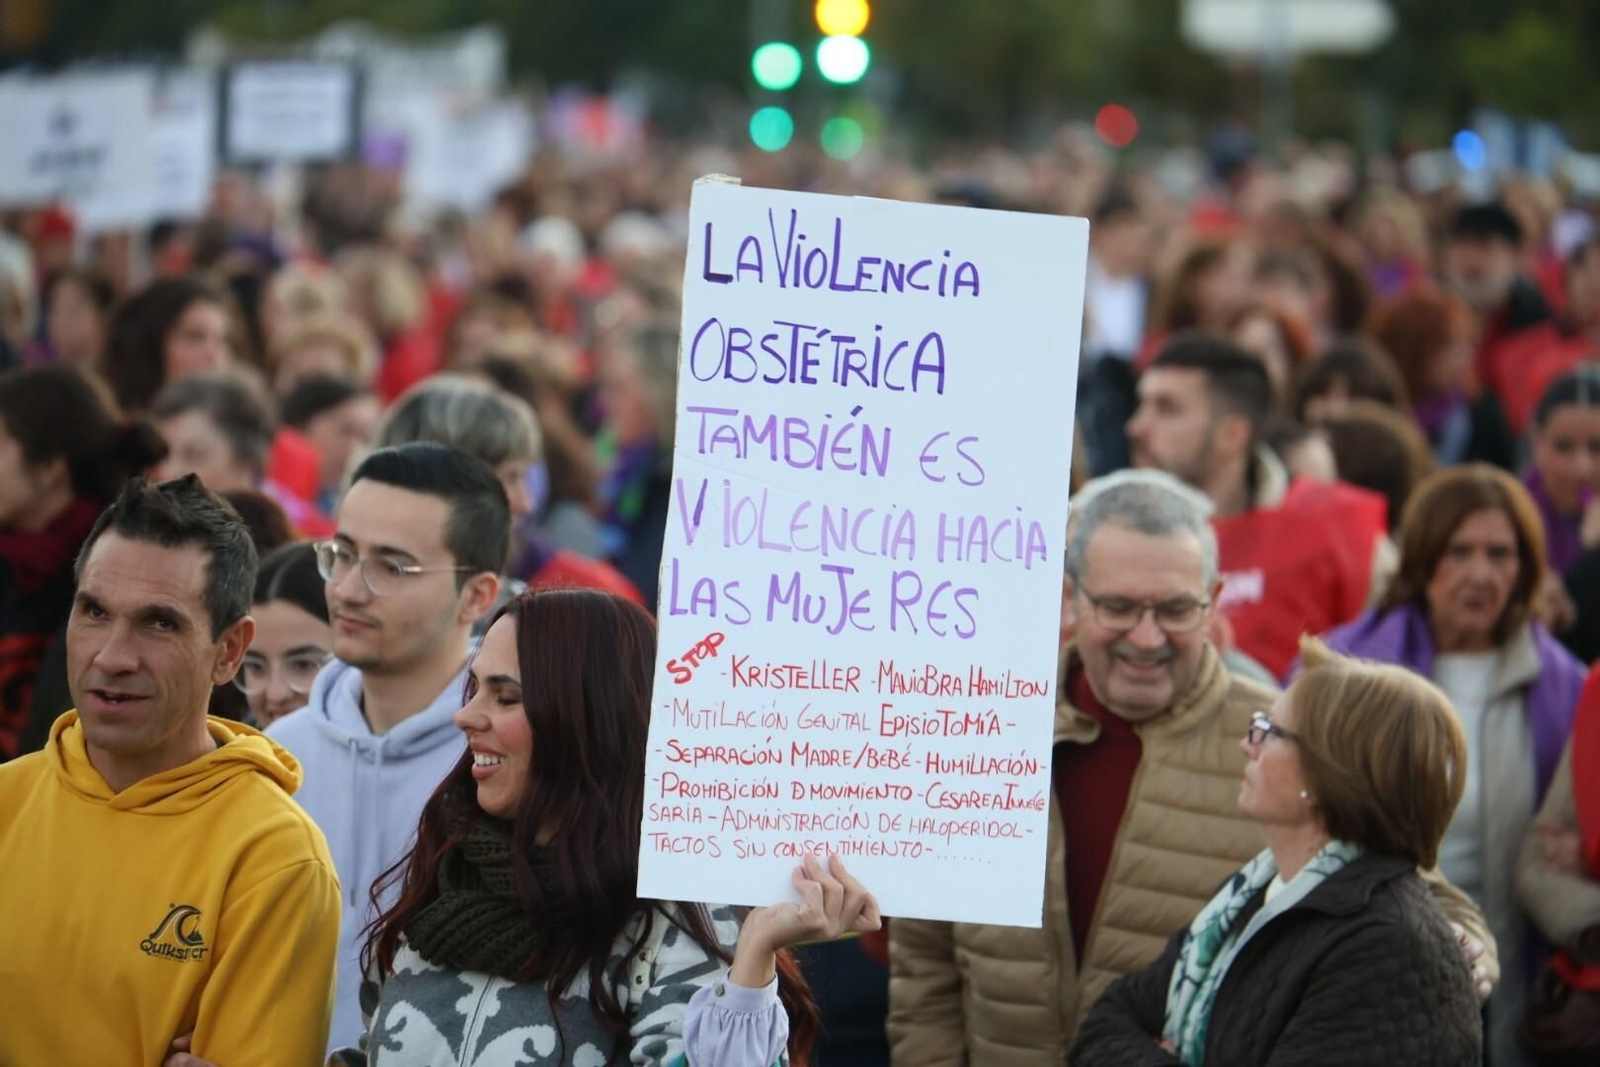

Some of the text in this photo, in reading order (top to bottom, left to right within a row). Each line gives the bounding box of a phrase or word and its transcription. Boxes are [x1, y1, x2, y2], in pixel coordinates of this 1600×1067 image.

[703, 207, 980, 297] LA VIOLENCIA
[690, 317, 945, 395] OBSTÉTRICA
[686, 405, 985, 486] TAMBIÉN ES
[676, 478, 1047, 570] VIOLENCIA HACIA
[670, 557, 979, 639] LAS MUJERES
[666, 632, 725, 684] STOP
[968, 664, 1048, 698] HAMILTON
[797, 703, 872, 732] GENITAL
[811, 782, 912, 800] MOVIMIENTO
[721, 804, 870, 832] ADMINISTRACIÓN
[879, 813, 901, 833] DE
[648, 832, 721, 858] TACTOS
[733, 838, 765, 859] SIN
